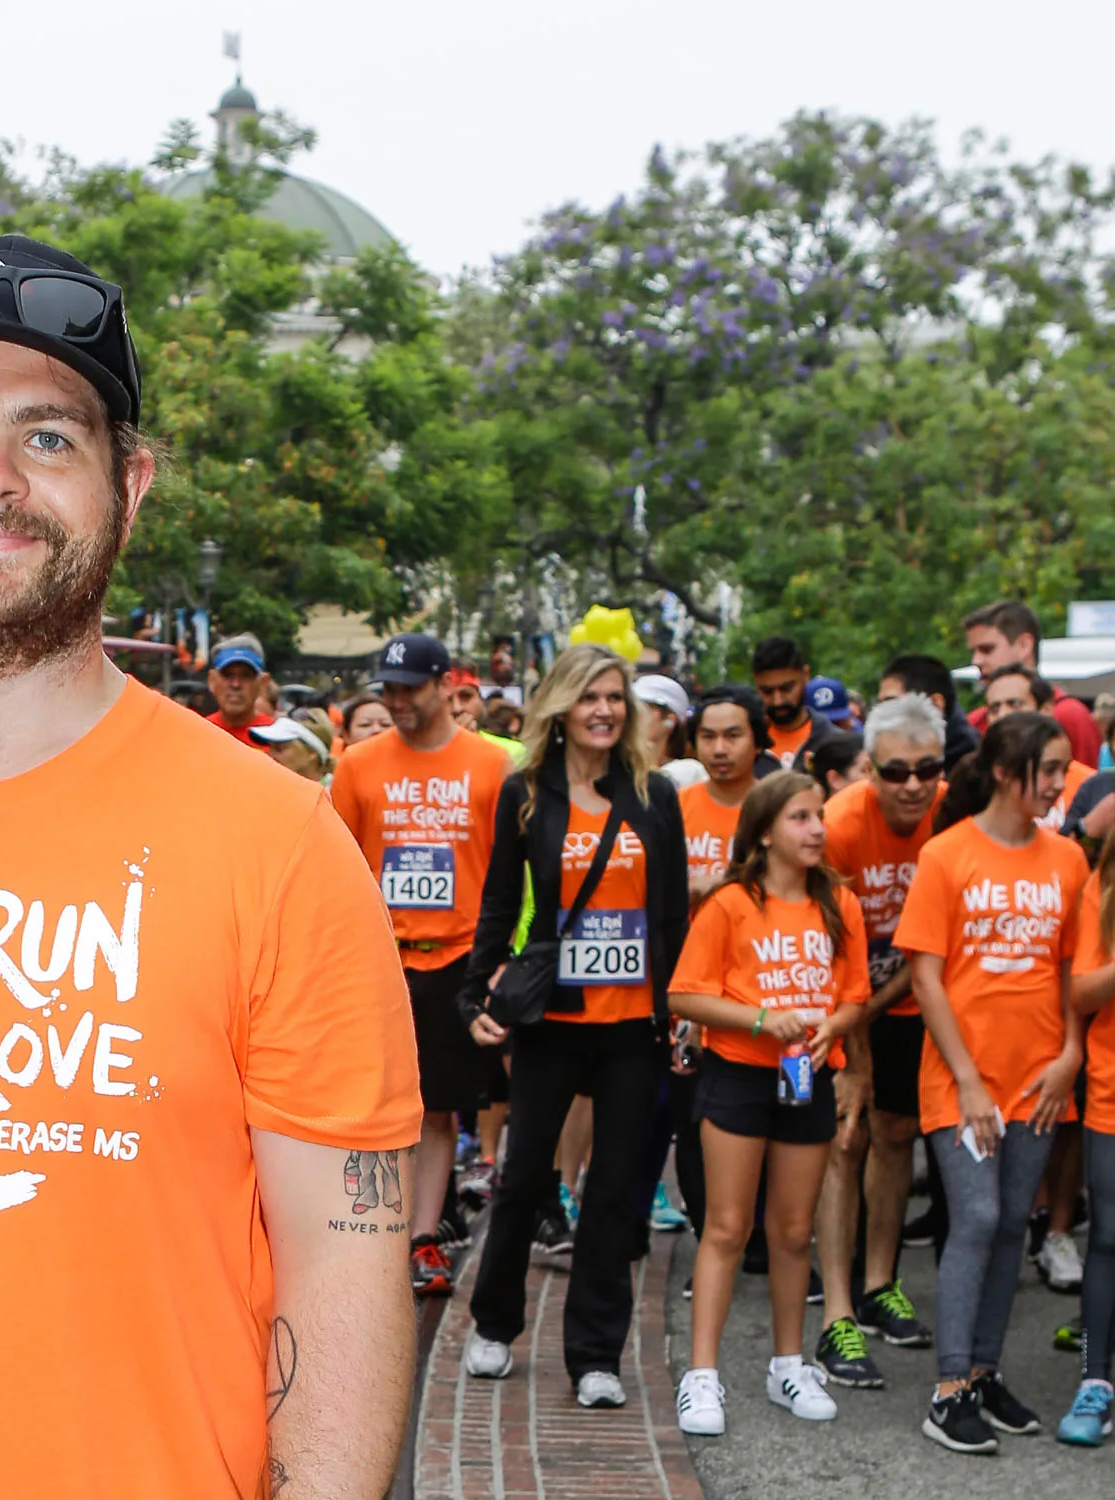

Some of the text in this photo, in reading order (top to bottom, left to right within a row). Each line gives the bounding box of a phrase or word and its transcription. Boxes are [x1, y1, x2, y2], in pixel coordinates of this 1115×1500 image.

[383, 770, 470, 807] WE RUN
[382, 805, 470, 830] THE GROVE
[685, 830, 722, 858] WE
[387, 876, 449, 901] 1402
[963, 872, 1062, 917] WE RUN
[567, 945, 640, 974] 1208
[751, 929, 834, 967] WE RU
[757, 962, 831, 992] THE GRO
[93, 1128, 141, 1161] MS
[328, 1220, 379, 1236] NEVER
